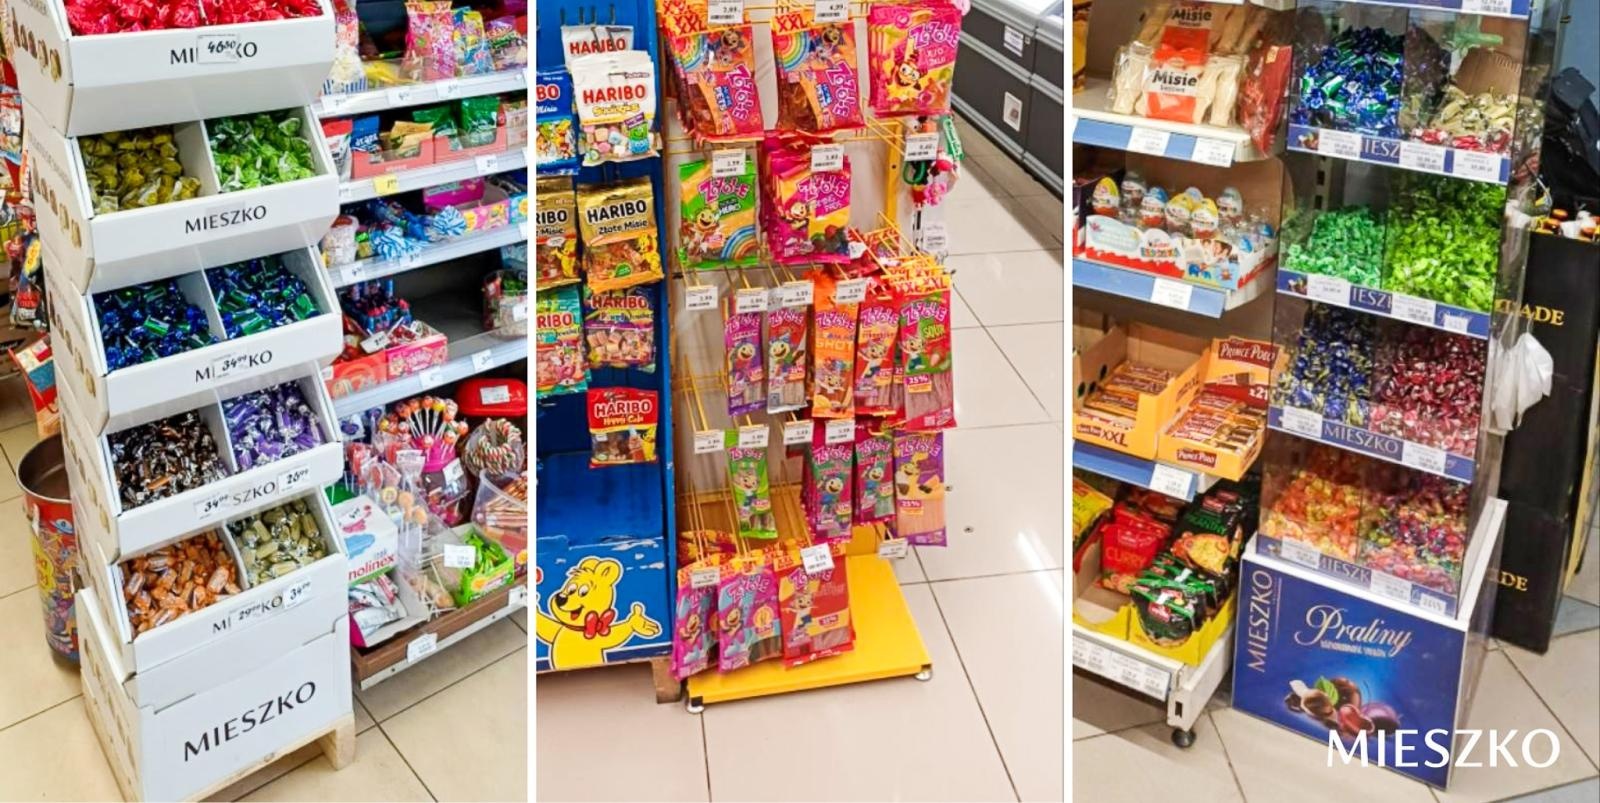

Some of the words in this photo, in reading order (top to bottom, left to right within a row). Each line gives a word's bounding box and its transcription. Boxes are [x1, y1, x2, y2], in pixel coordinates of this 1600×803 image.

[777, 13, 806, 33] XXL
[1171, 8, 1212, 22] Misie
[570, 38, 627, 55] HARIBO
[1152, 69, 1198, 86] Misie
[582, 84, 647, 104] HARIBO
[184, 205, 268, 235] MIESZKO
[586, 199, 647, 225] HARIBO
[623, 219, 648, 231] Misie
[591, 295, 648, 310] HARIBO
[1220, 342, 1251, 358] PRINCE
[594, 399, 652, 417] HARIBO
[1101, 429, 1129, 448] XXL
[1323, 422, 1400, 454] MIESZKO
[1247, 569, 1274, 674] MIESZKO
[1293, 604, 1414, 659] Praliny
[183, 680, 317, 763] MIESZKO
